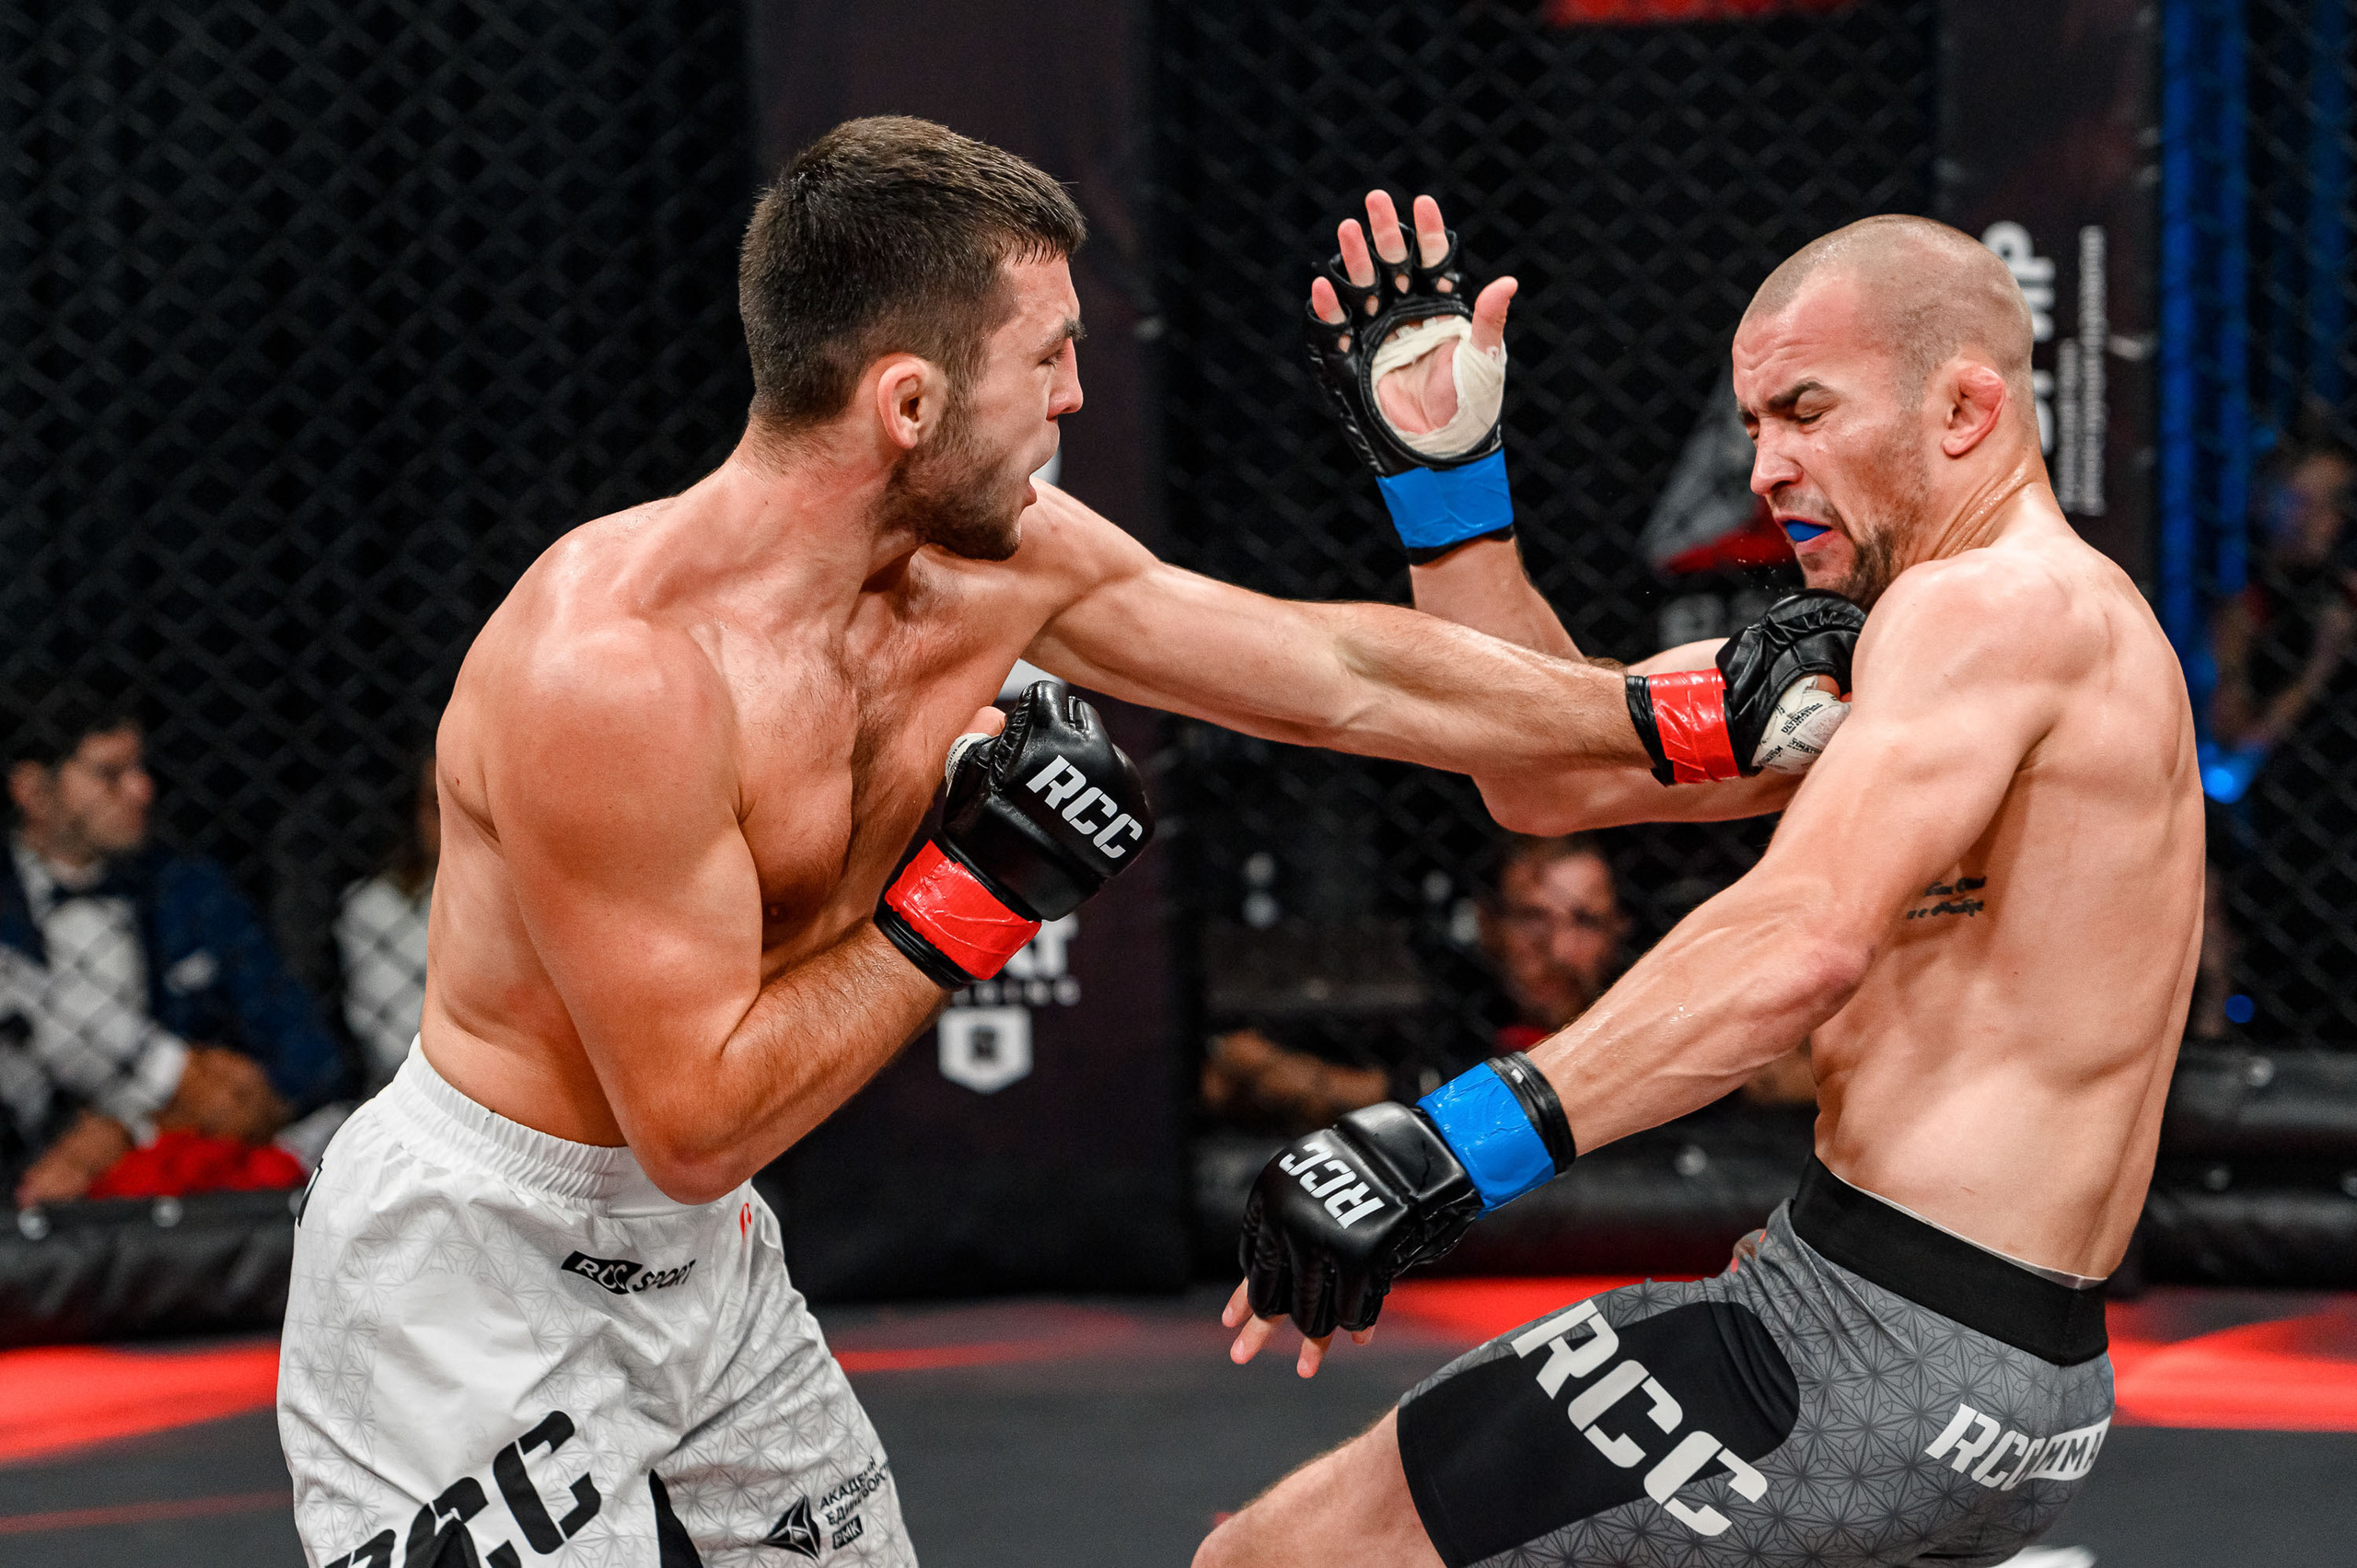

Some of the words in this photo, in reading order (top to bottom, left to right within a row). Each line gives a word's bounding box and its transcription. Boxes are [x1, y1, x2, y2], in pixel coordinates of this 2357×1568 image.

[1026, 754, 1144, 859] RCC
[1279, 1142, 1386, 1229] RCC
[575, 1258, 628, 1290] RCC
[632, 1259, 696, 1292] SPORT
[1510, 1299, 1768, 1537] RCC
[1924, 1402, 2046, 1492] RCC
